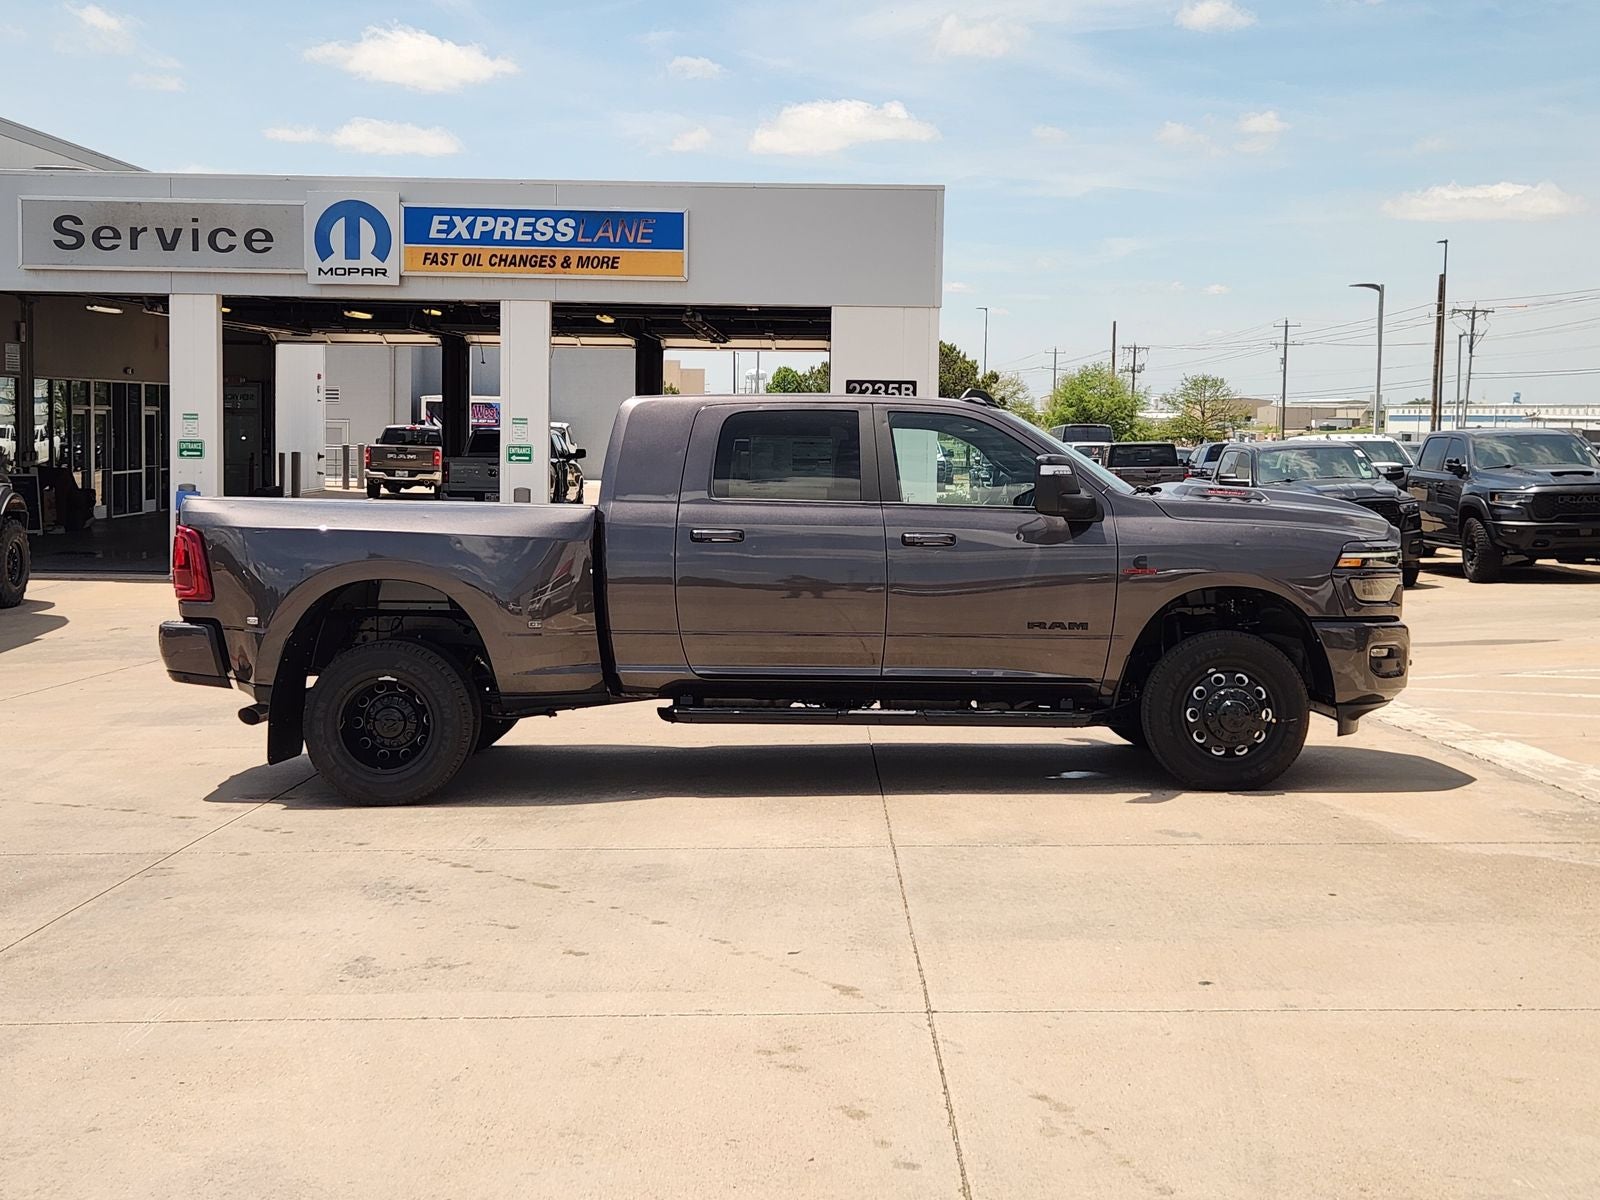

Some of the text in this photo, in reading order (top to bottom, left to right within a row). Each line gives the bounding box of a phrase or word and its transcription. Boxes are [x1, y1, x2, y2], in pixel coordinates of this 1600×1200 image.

[52, 214, 275, 254] Service
[422, 252, 621, 270] FAST OIL CHANGES & MORE
[317, 266, 389, 278] MOPAR
[180, 442, 202, 450] ENTRANCE
[509, 447, 531, 455] ENTRANCE
[1027, 621, 1089, 631] RAM
